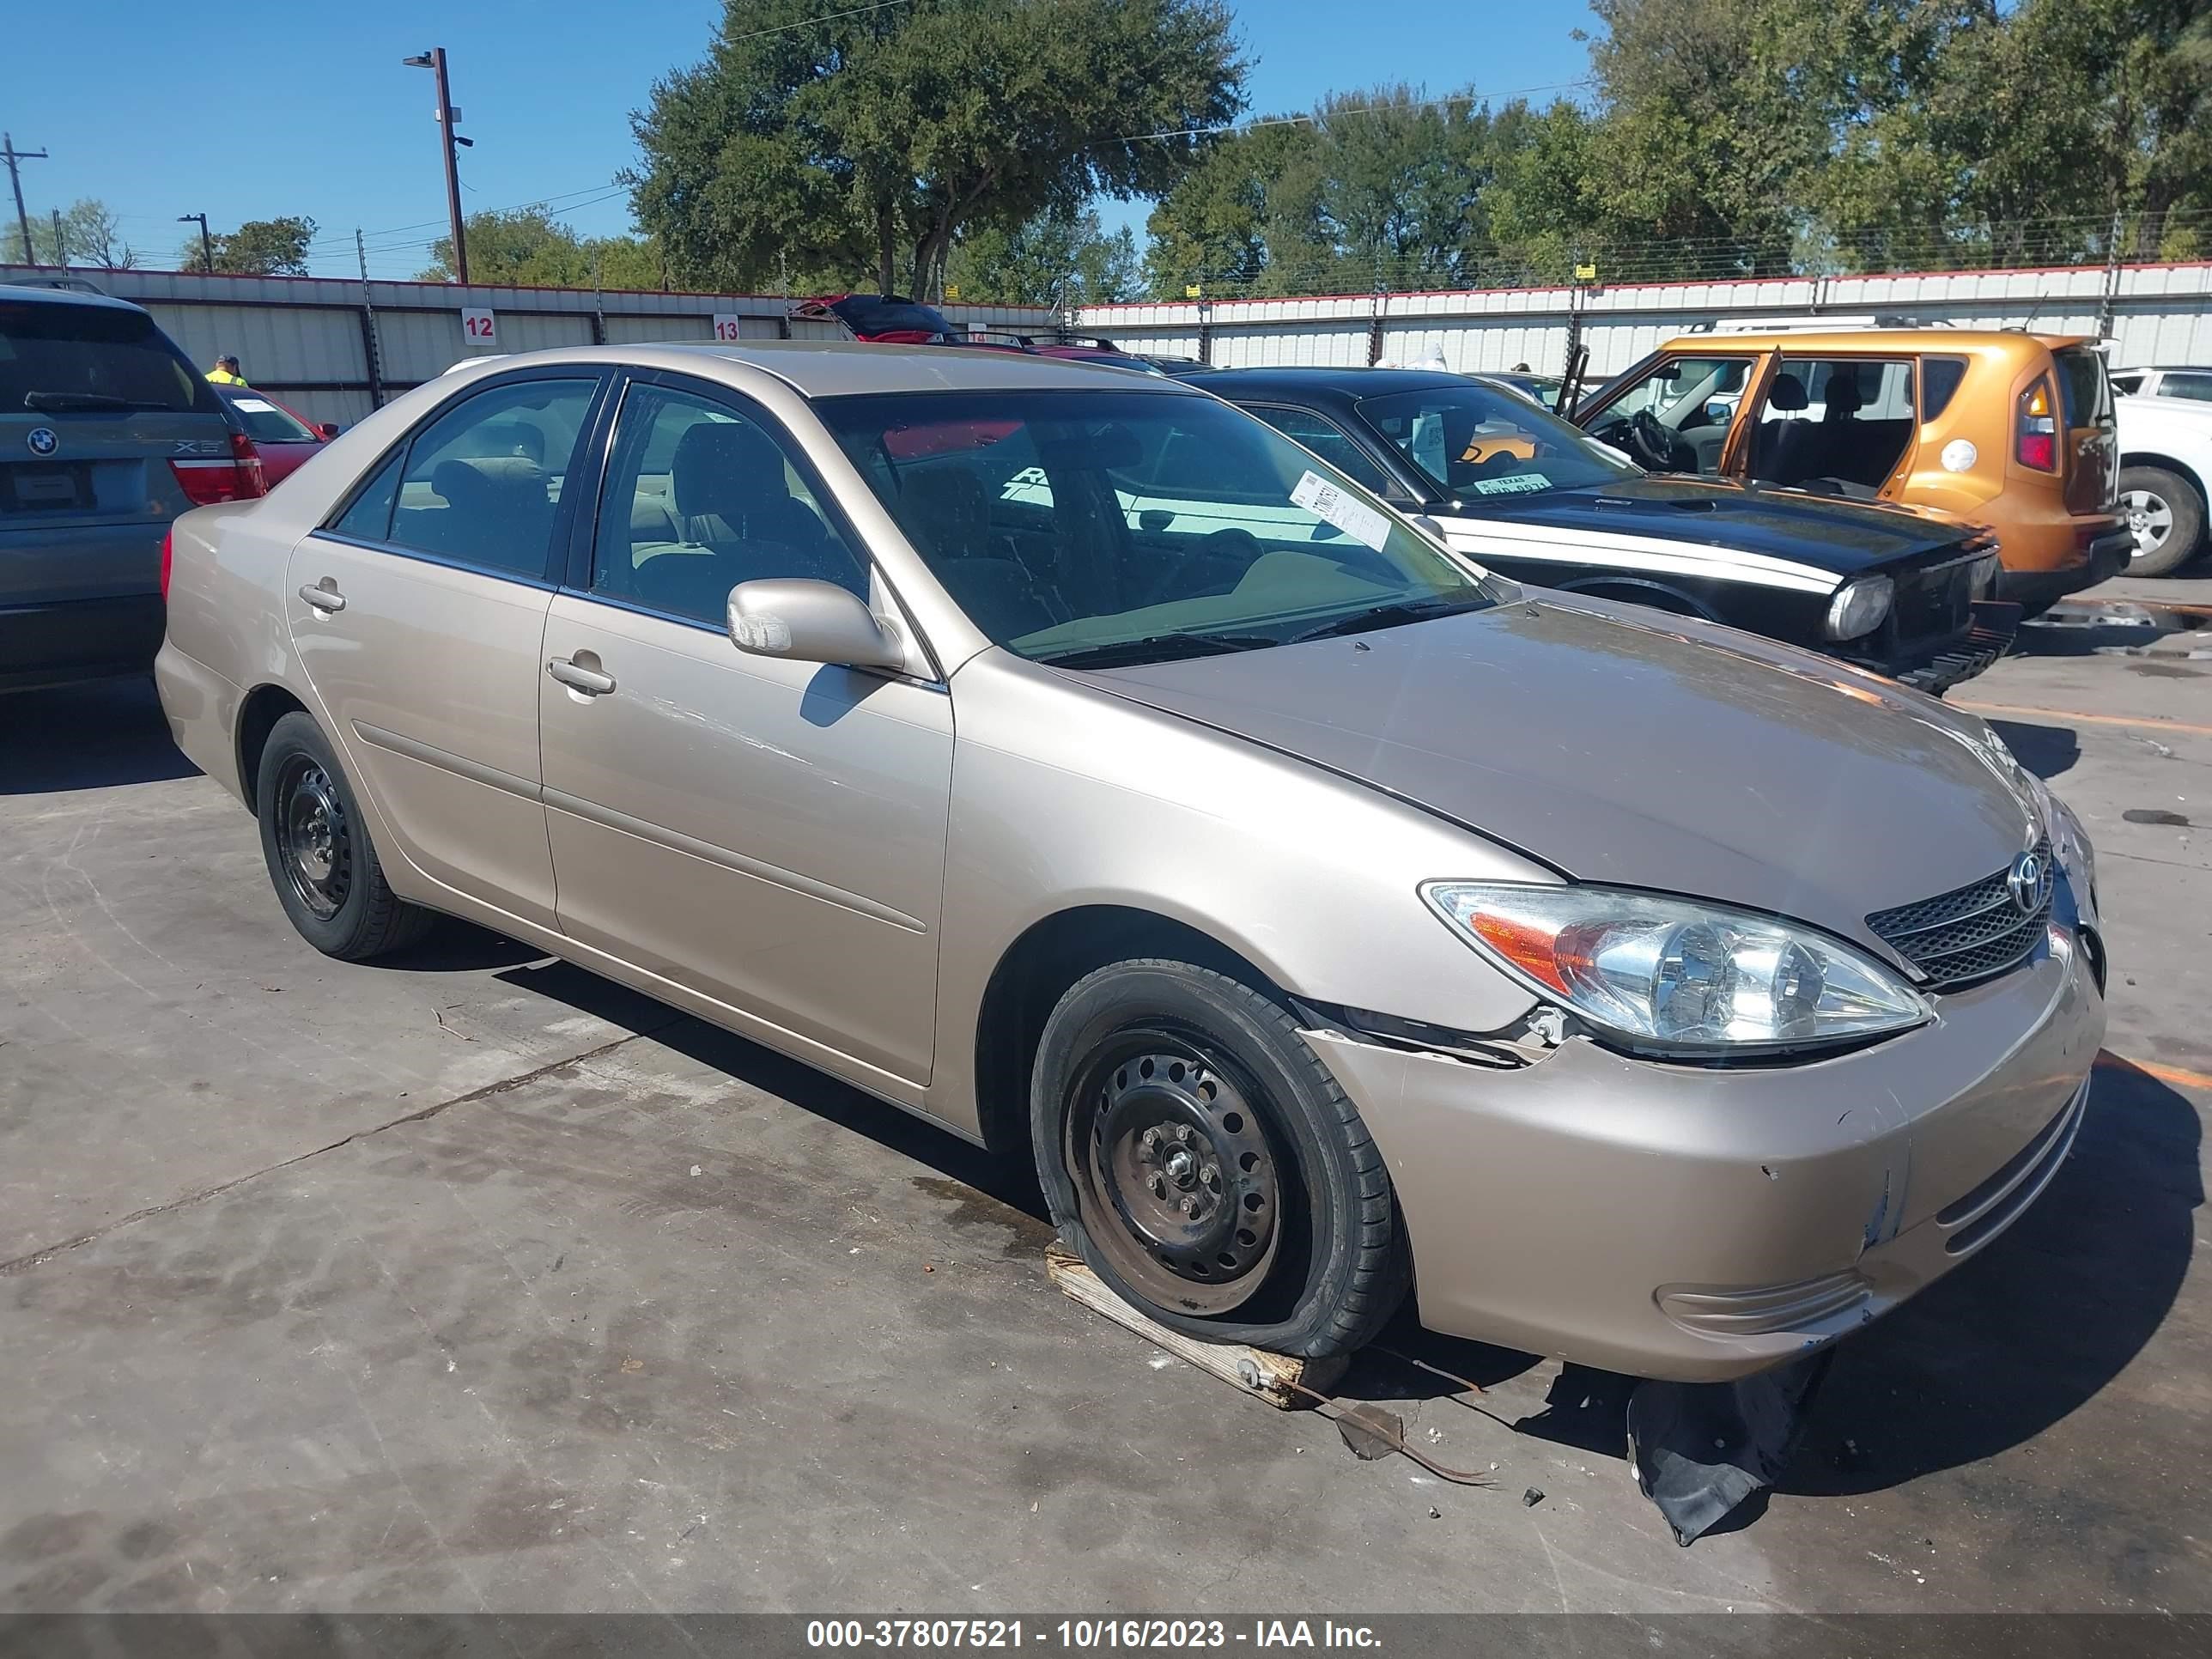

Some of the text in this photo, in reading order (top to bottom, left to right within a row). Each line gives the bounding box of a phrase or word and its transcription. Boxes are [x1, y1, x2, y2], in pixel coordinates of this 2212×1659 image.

[466, 317, 494, 337] 12
[717, 322, 738, 341] 13
[970, 330, 986, 343] 14
[1496, 477, 1526, 486] TEXAS
